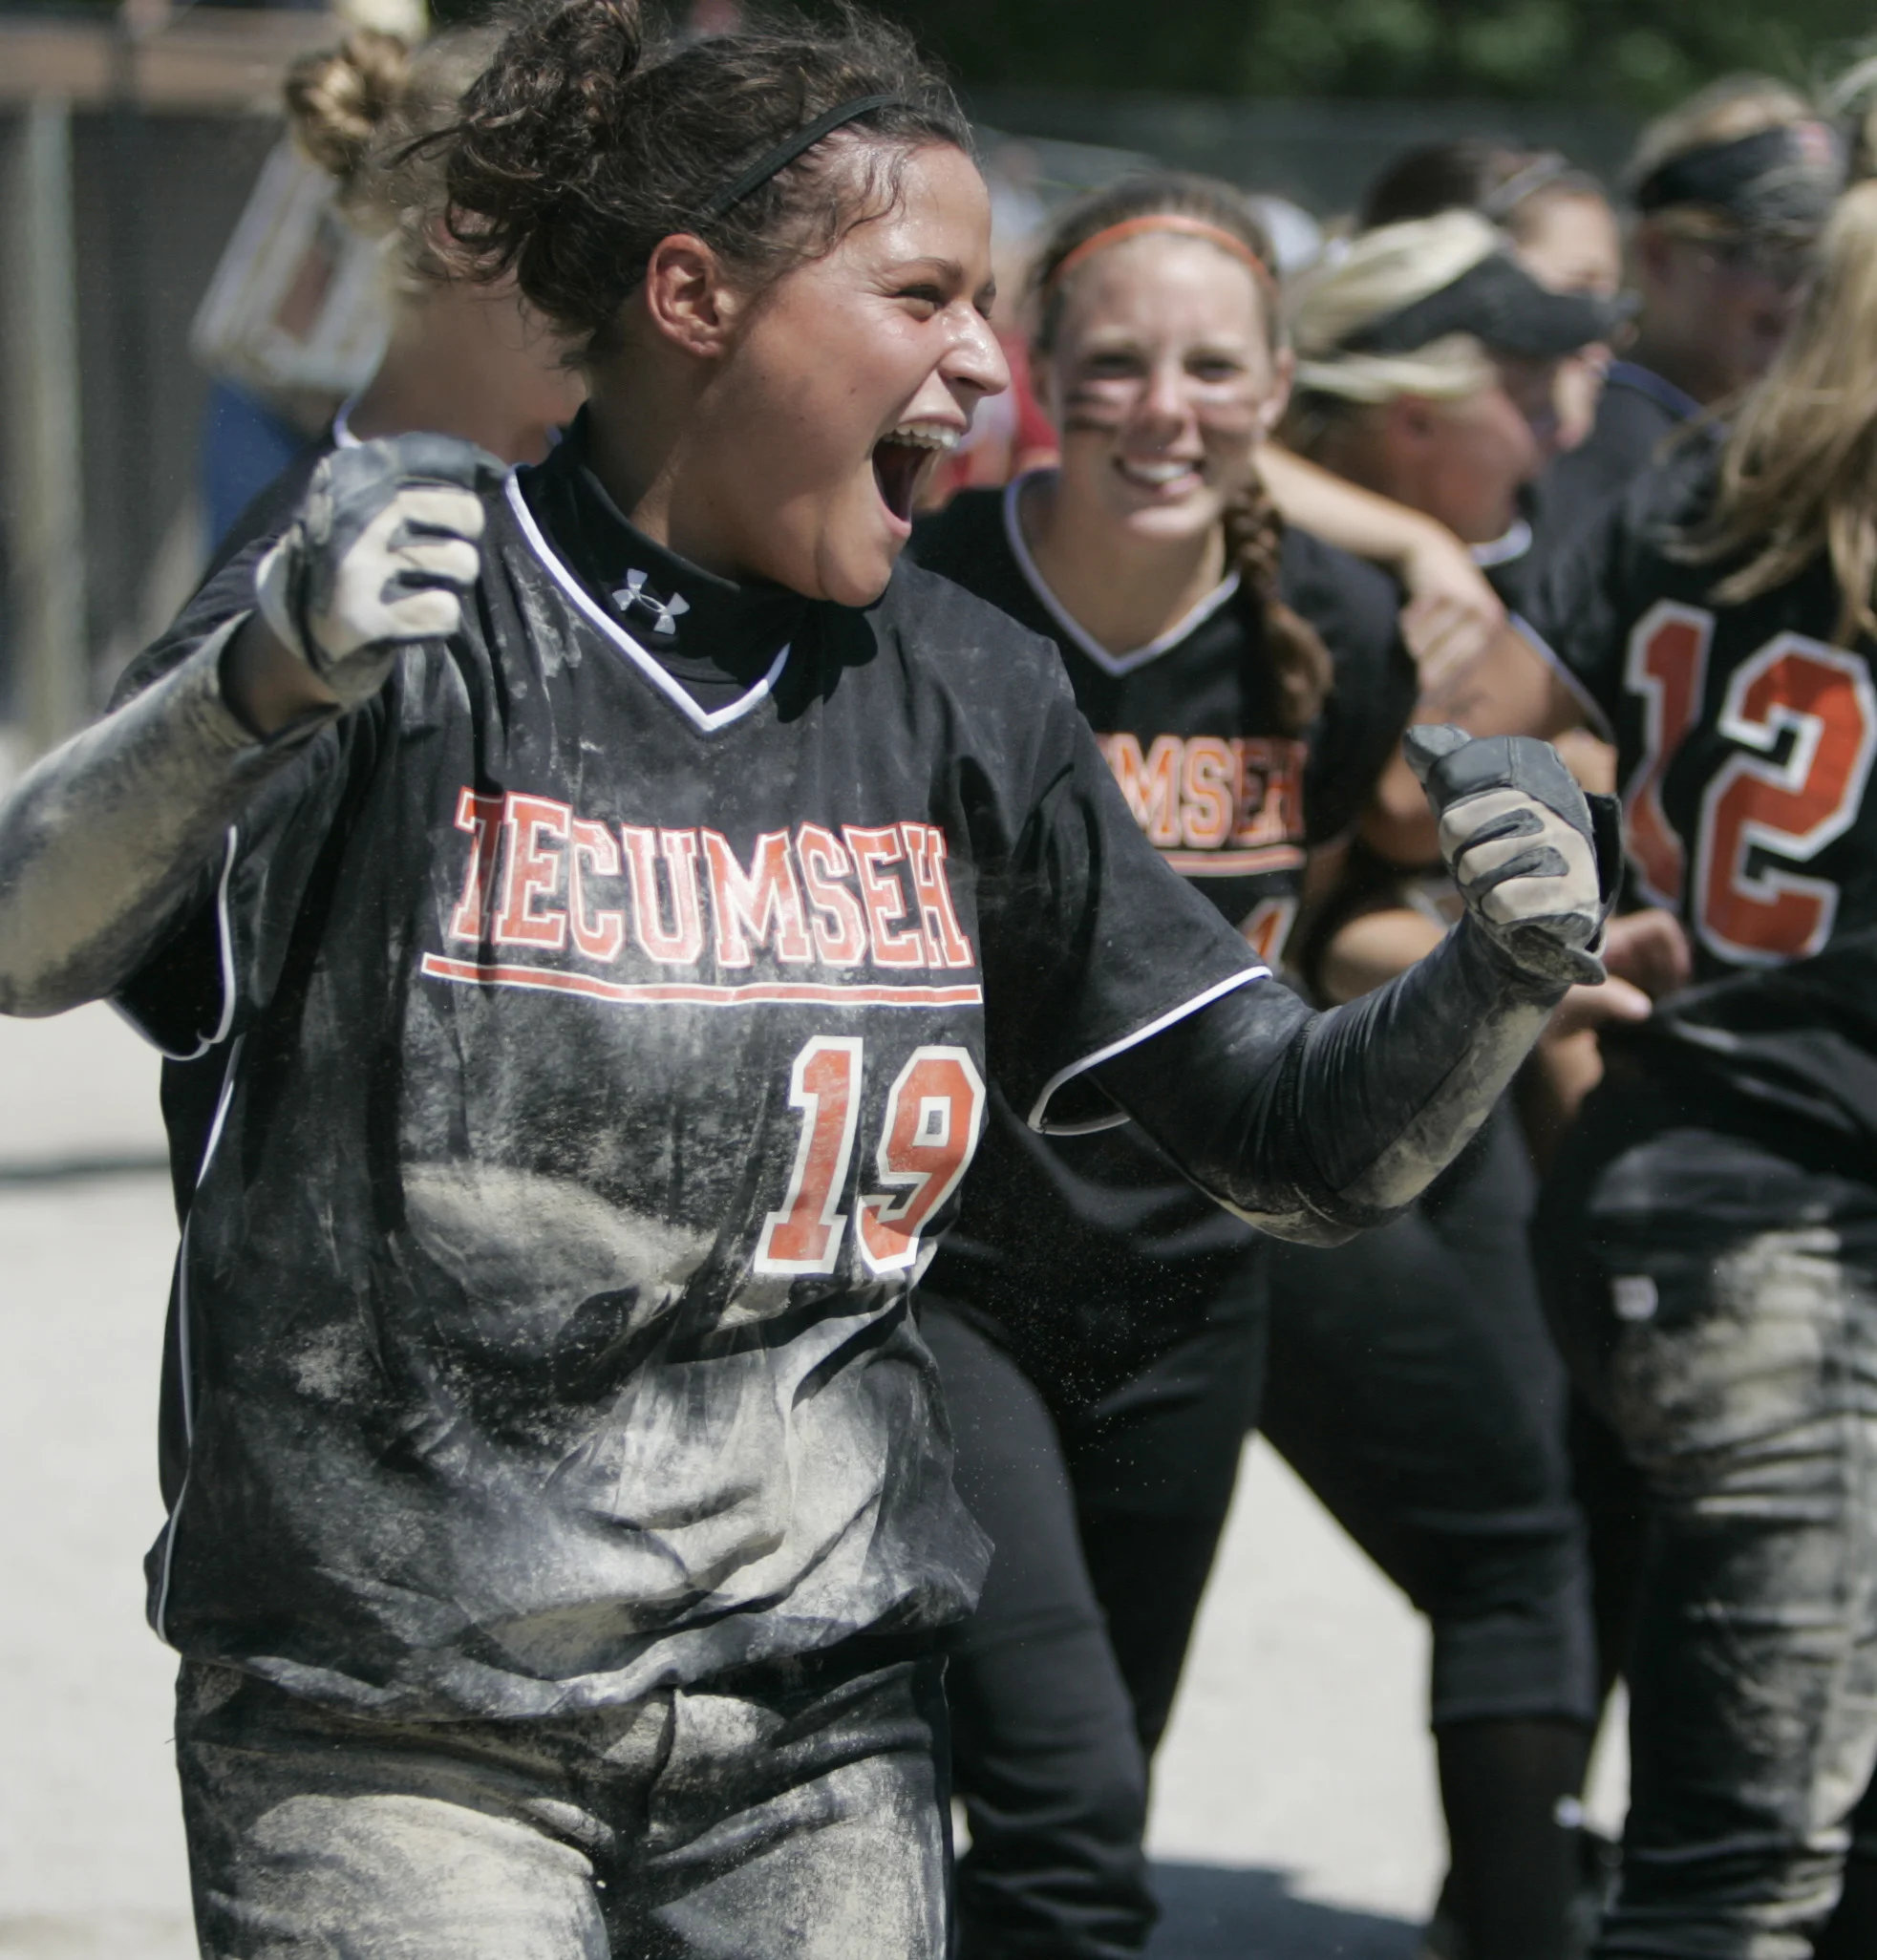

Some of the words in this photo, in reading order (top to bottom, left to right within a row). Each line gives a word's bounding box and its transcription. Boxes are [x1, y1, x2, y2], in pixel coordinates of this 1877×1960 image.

[449, 785, 975, 970] TECUMSEH
[1096, 733, 1309, 848] MSEH
[1626, 598, 1877, 969] 12
[753, 1034, 987, 1273] 19
